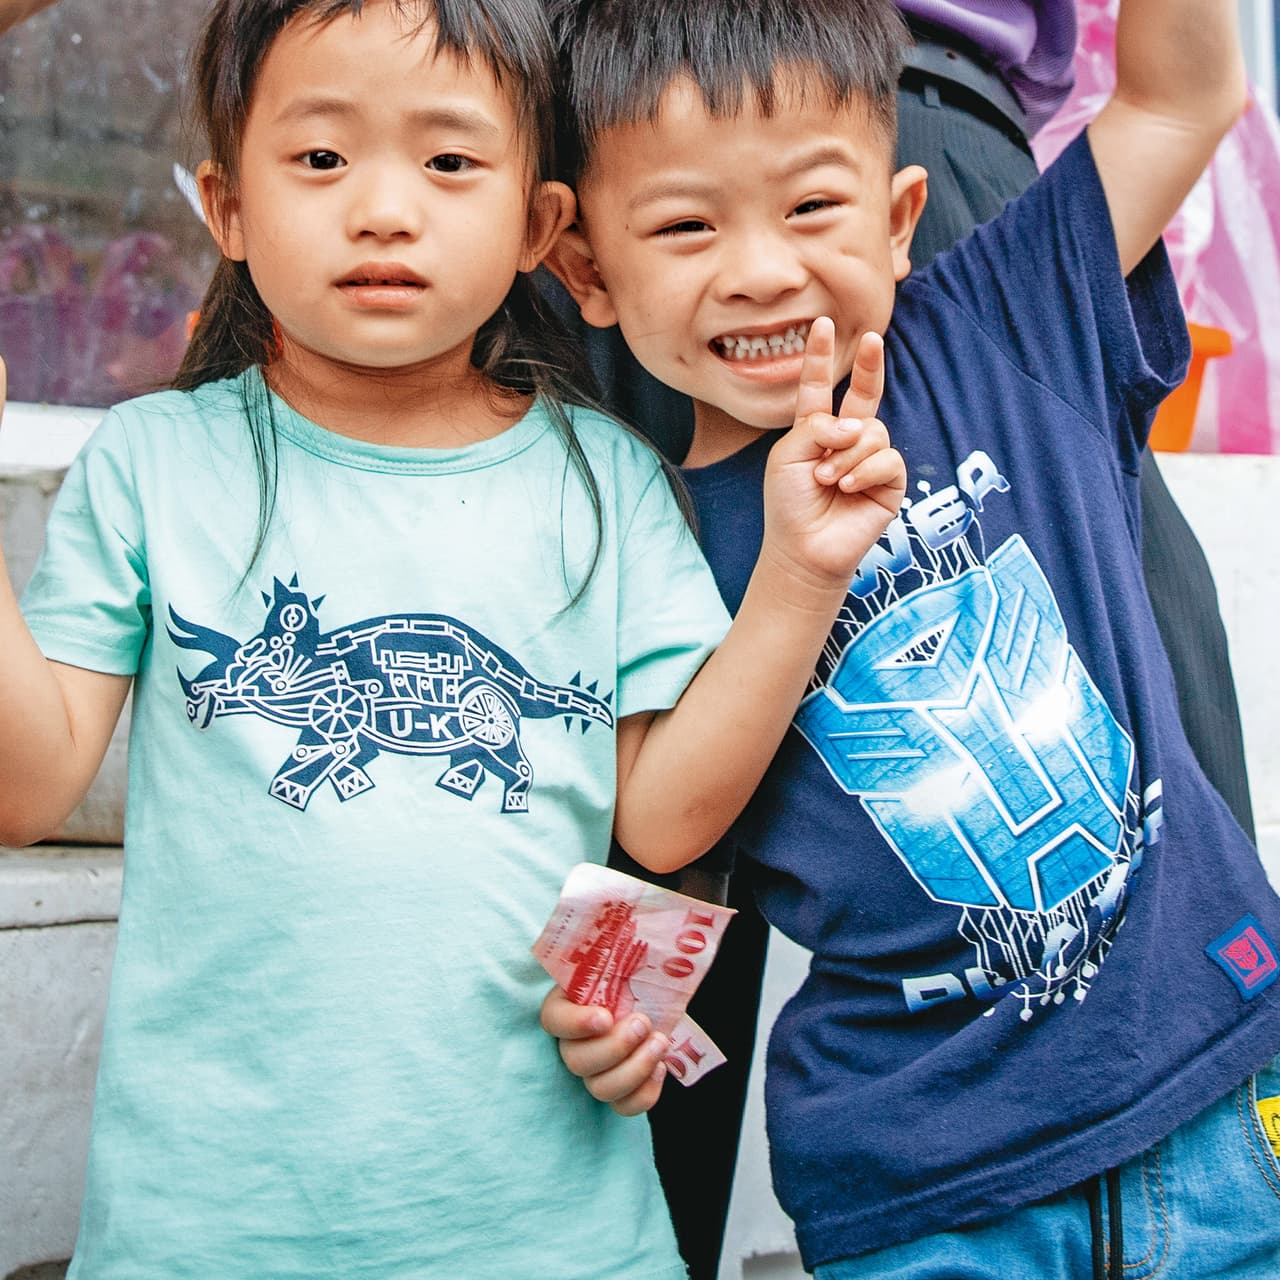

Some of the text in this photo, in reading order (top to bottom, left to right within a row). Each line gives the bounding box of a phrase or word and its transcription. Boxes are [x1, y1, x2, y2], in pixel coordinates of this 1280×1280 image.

[848, 450, 1011, 599] WER
[389, 709, 455, 740] U-K
[662, 908, 716, 978] 100
[664, 1036, 707, 1079] 10
